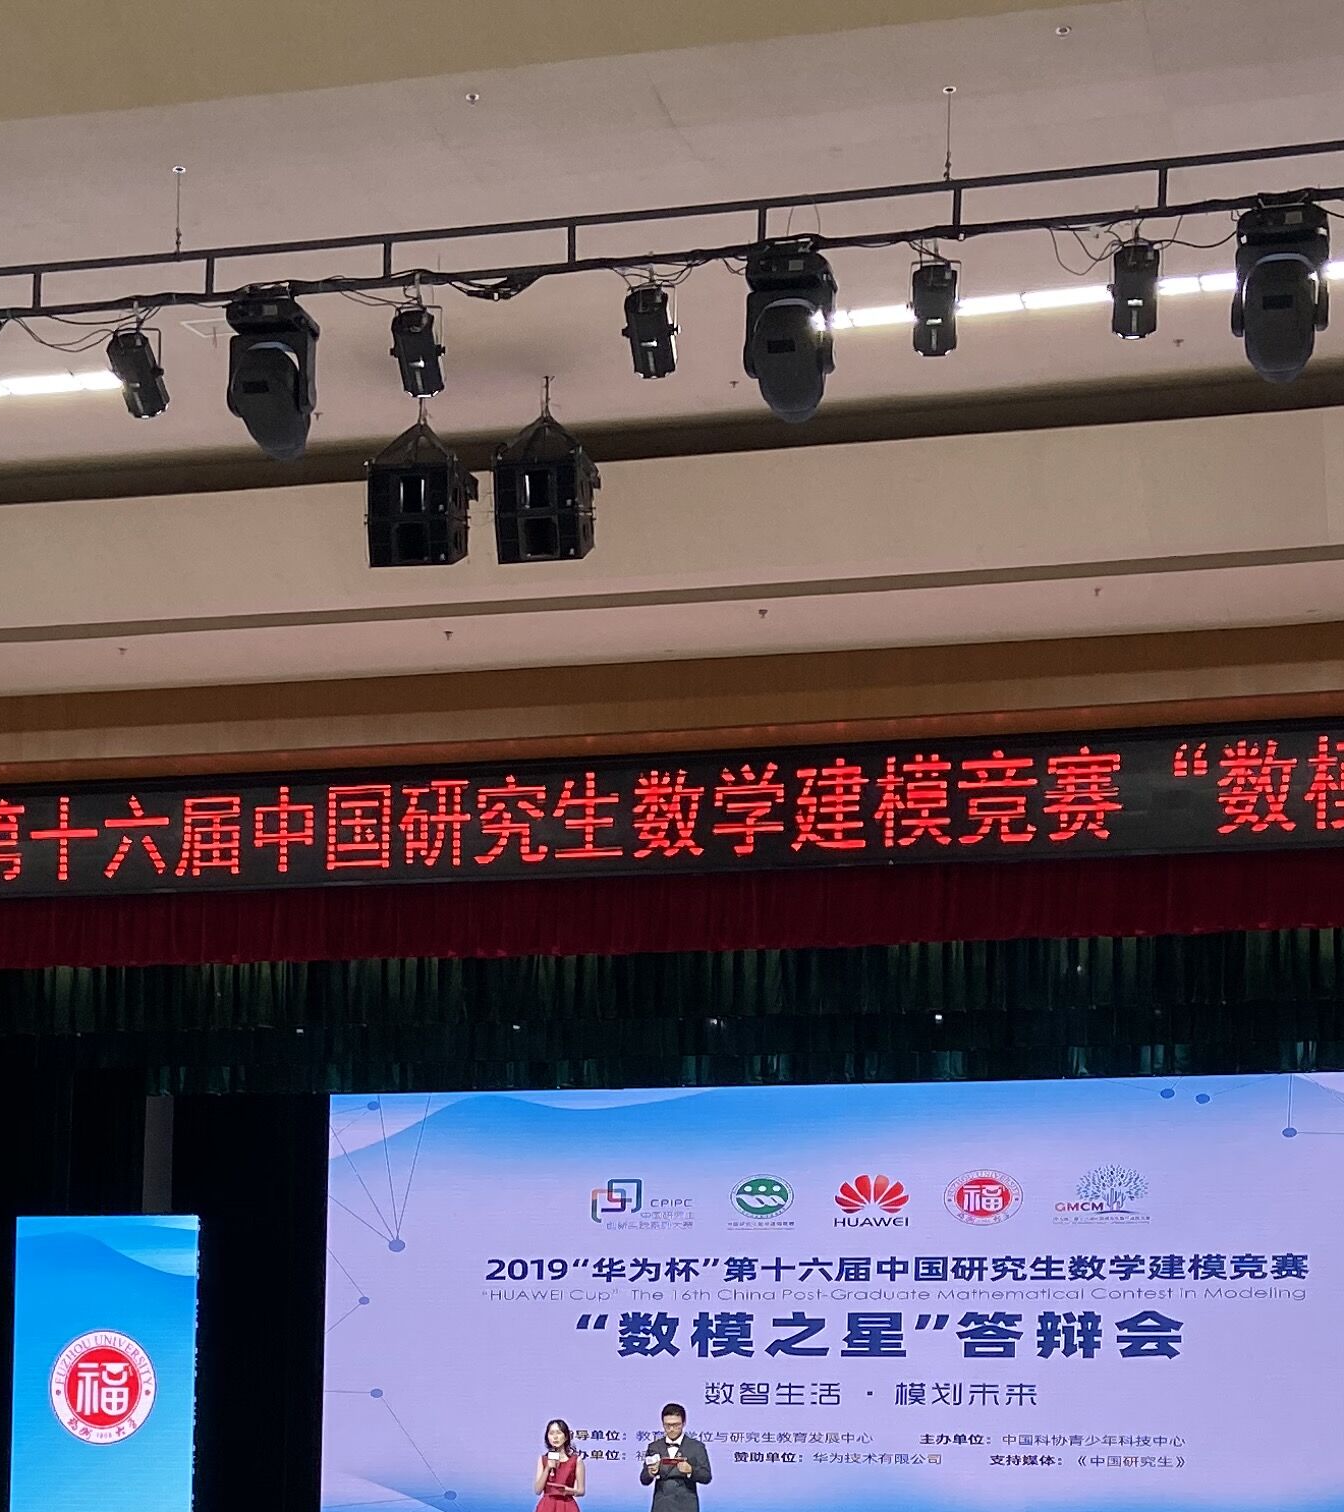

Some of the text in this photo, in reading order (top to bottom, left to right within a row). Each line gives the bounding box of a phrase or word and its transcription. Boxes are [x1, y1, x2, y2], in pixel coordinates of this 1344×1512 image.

[649, 1199, 693, 1208] CPIPC
[1054, 1202, 1105, 1212] GMCM
[833, 1216, 909, 1228] HUAWEI
[632, 1289, 664, 1301] The
[672, 1289, 711, 1301] 16th
[717, 1289, 776, 1301] China
[782, 1289, 931, 1301] Post-Graduate
[937, 1288, 1084, 1301] Mathematical
[1090, 1287, 1174, 1300] Contest
[1179, 1288, 1197, 1300] in
[1203, 1287, 1307, 1304] Modeling
[76, 1361, 133, 1416] 福
